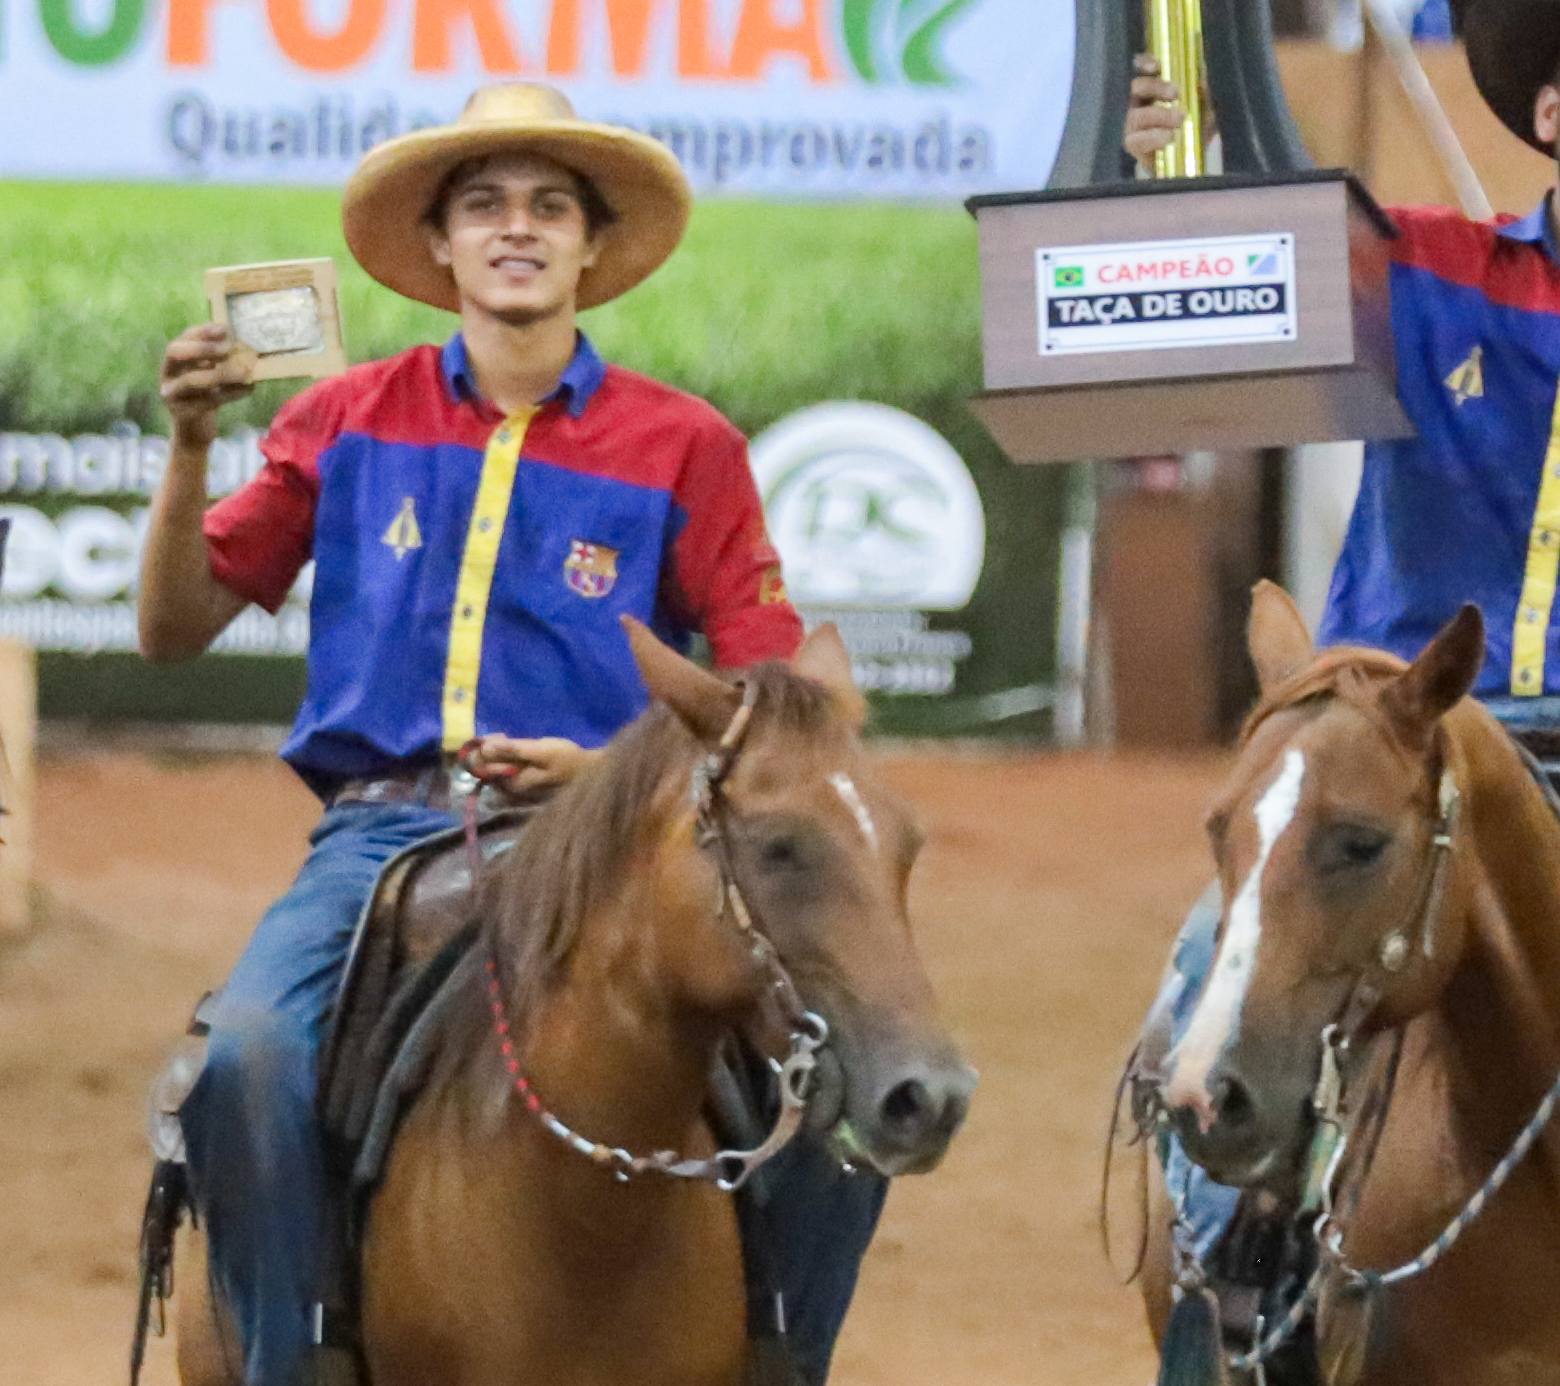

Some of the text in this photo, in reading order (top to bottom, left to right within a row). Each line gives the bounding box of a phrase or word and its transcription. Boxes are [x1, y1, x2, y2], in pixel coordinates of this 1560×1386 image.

[1097, 254, 1236, 284] CAMPEÃO
[1053, 286, 1280, 326] TAÇA DE OURO
